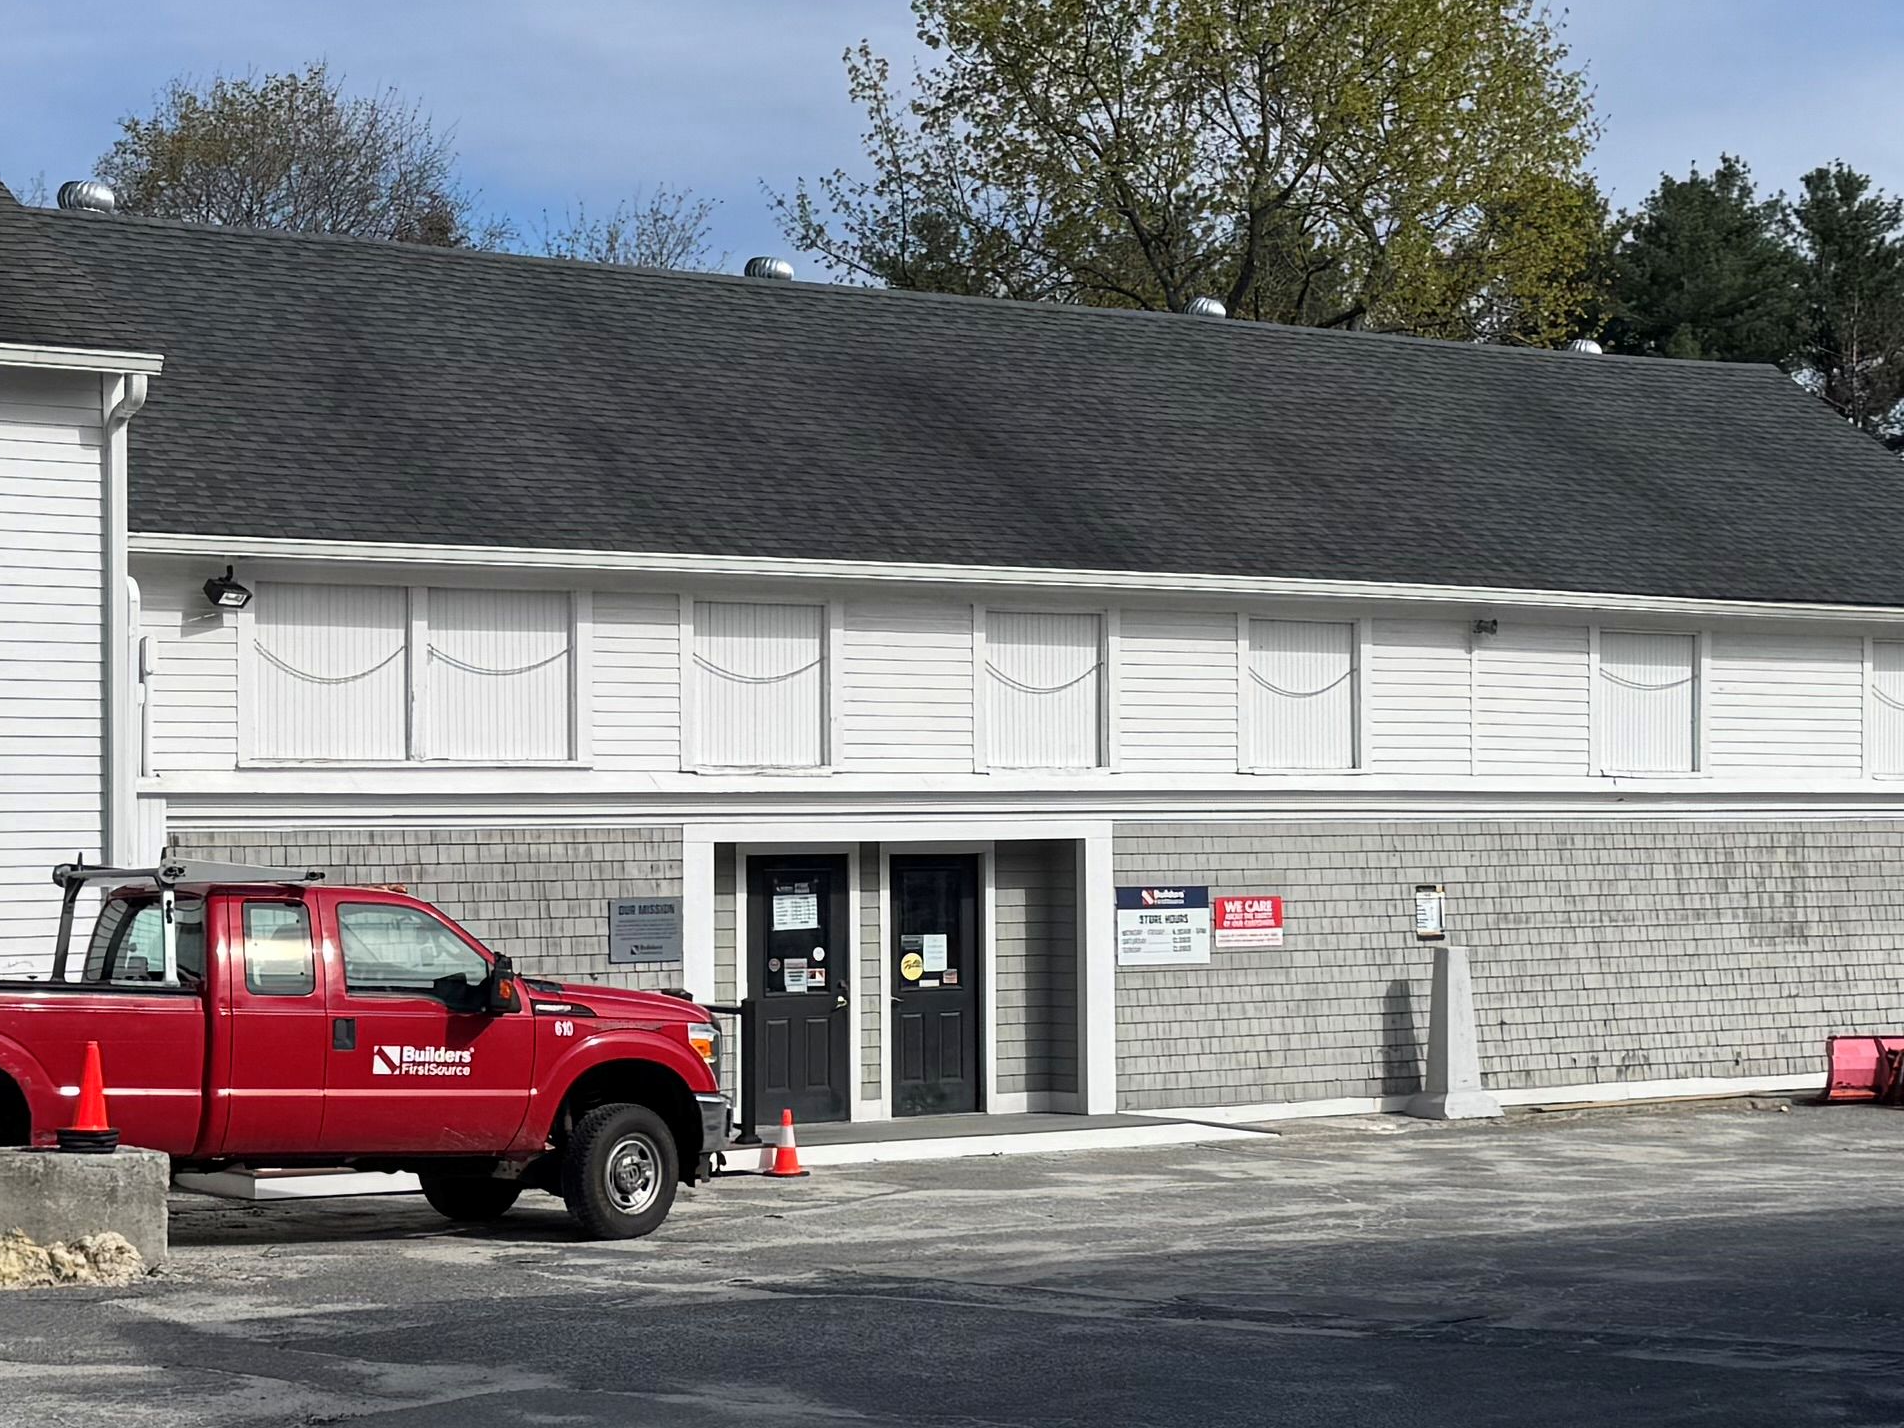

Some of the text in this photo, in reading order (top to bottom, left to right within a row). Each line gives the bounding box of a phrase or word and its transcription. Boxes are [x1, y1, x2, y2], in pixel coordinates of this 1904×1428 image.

[639, 904, 675, 915] MISSION
[1224, 899, 1273, 913] WE CARE
[1139, 913, 1189, 925] STORE HOURS
[554, 1020, 575, 1036] 610
[402, 1045, 472, 1063] Builders
[401, 1063, 471, 1076] FirstSource
